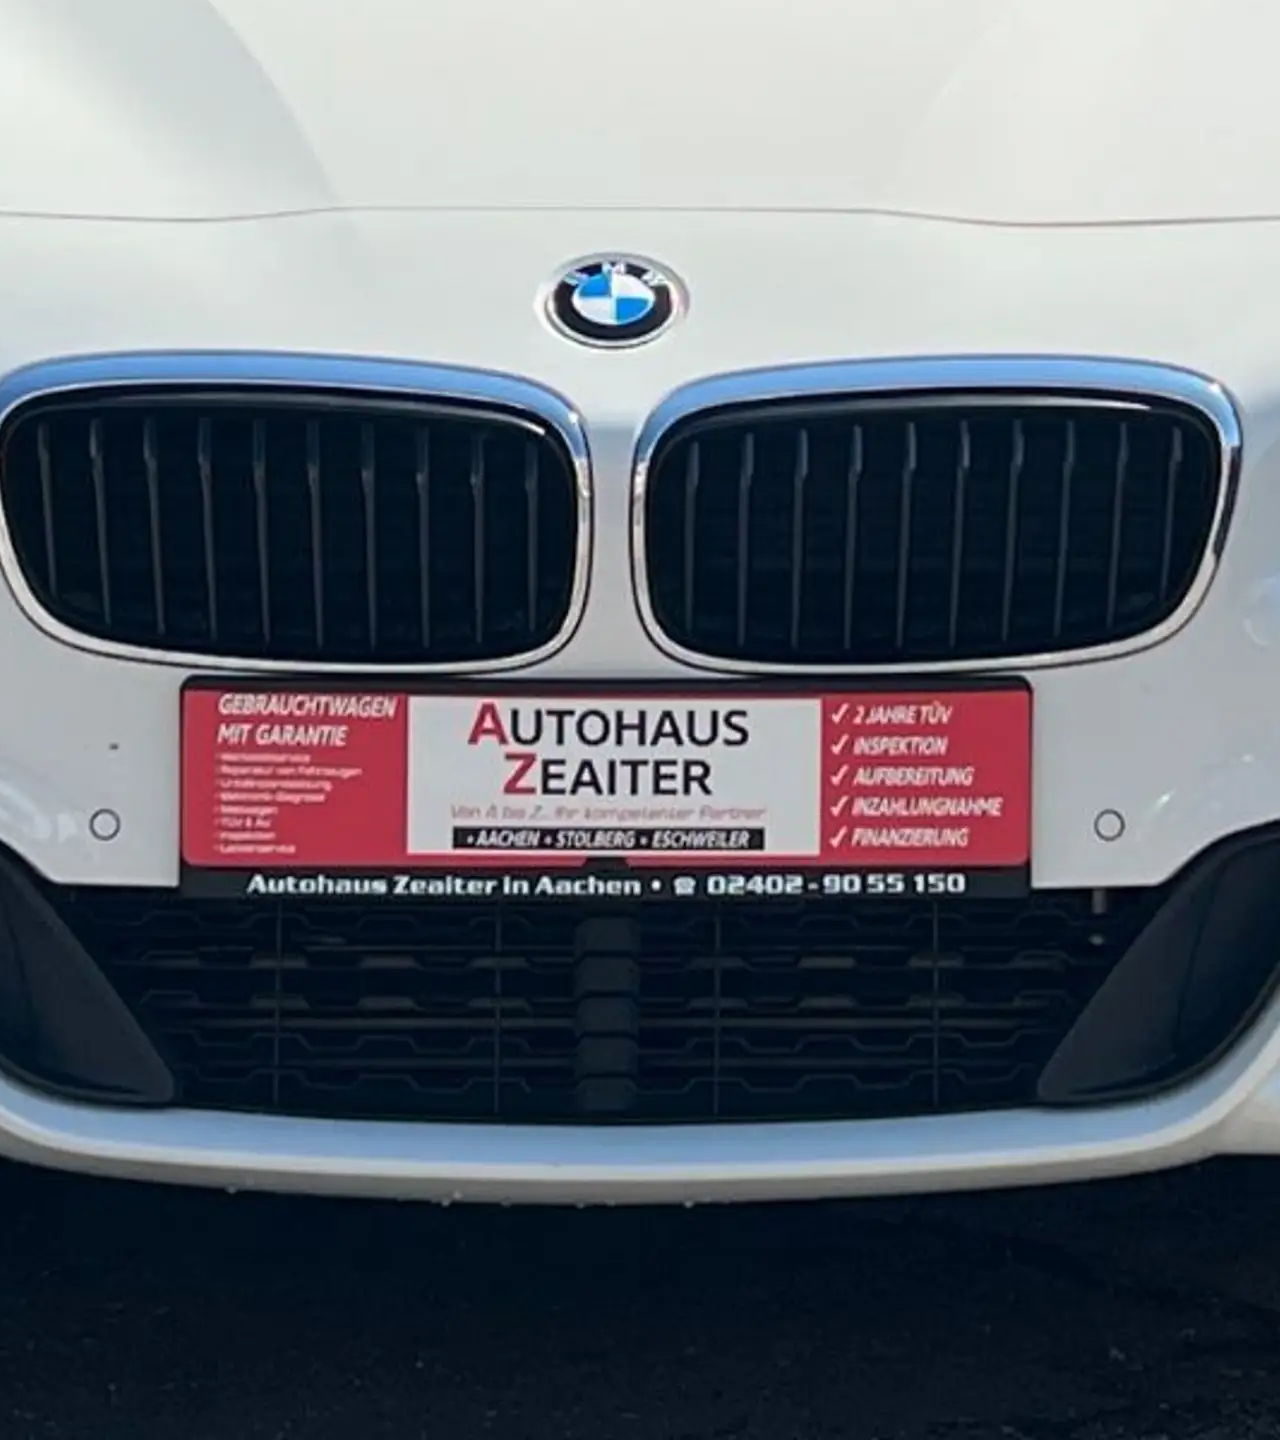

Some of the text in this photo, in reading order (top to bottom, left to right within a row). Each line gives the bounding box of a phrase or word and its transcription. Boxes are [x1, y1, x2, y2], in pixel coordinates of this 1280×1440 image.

[218, 694, 398, 720] GEBRAUCHTWAGEN
[853, 700, 953, 725] 2 JAHRE TÜV
[218, 724, 349, 748] MIT GARANTIE
[467, 702, 749, 747] AUTOHAUS
[853, 736, 948, 755] INSPEKTION
[503, 752, 712, 795] ZEAITER
[853, 767, 975, 787] AUFBEREITUNG
[851, 797, 1002, 818] INZAHLUNGNAHME
[476, 830, 750, 848] AACHEN STOLBERG ESCHWEILER
[851, 828, 970, 848] FINANZIERUNG
[246, 874, 388, 896] Autohaus
[392, 874, 499, 896] Zeaiter
[534, 875, 642, 897] Aachen
